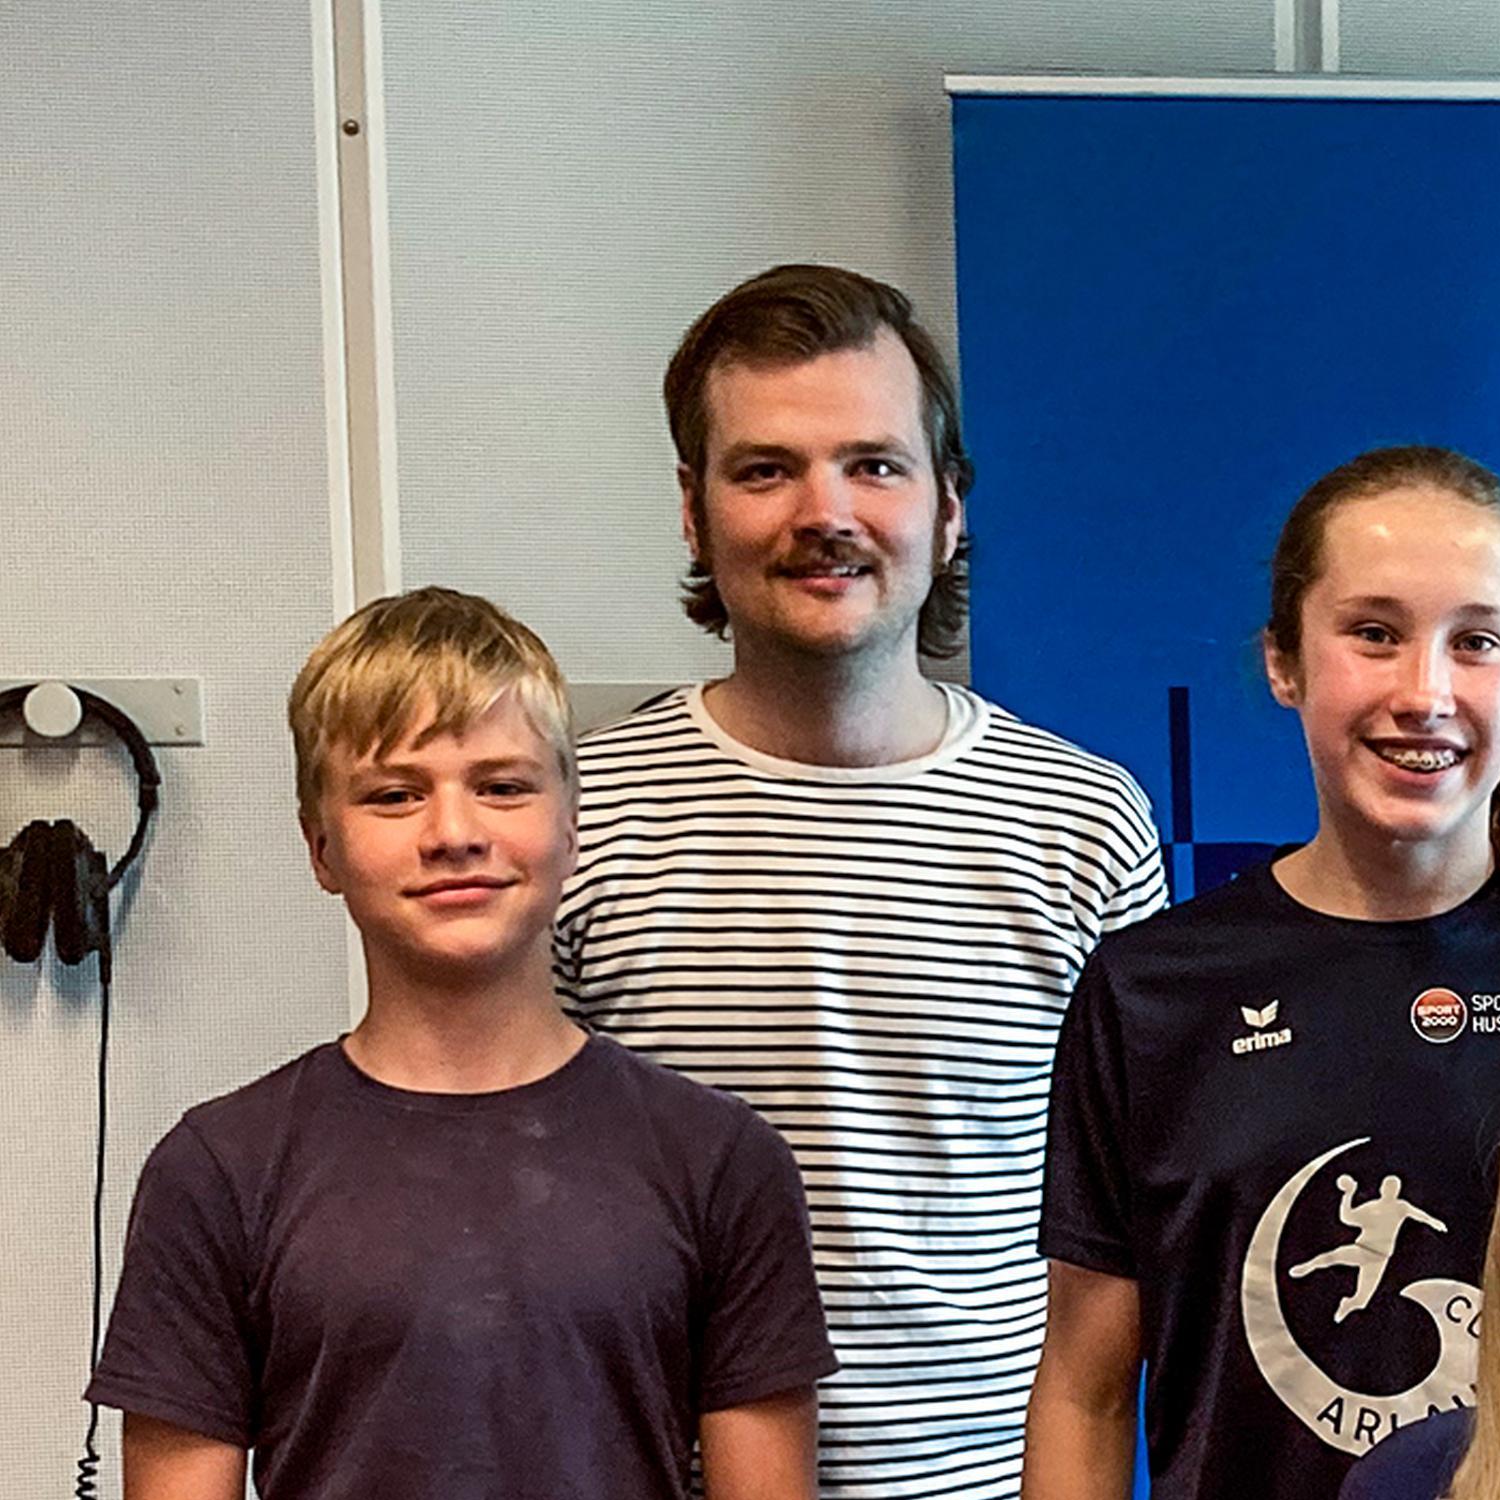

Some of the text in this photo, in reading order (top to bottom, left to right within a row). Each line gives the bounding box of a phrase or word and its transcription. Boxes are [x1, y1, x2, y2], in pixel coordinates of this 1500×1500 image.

[1416, 1004, 1461, 1017] SPORT
[1421, 1015, 1458, 1027] 2000
[1232, 1028, 1293, 1055] erima
